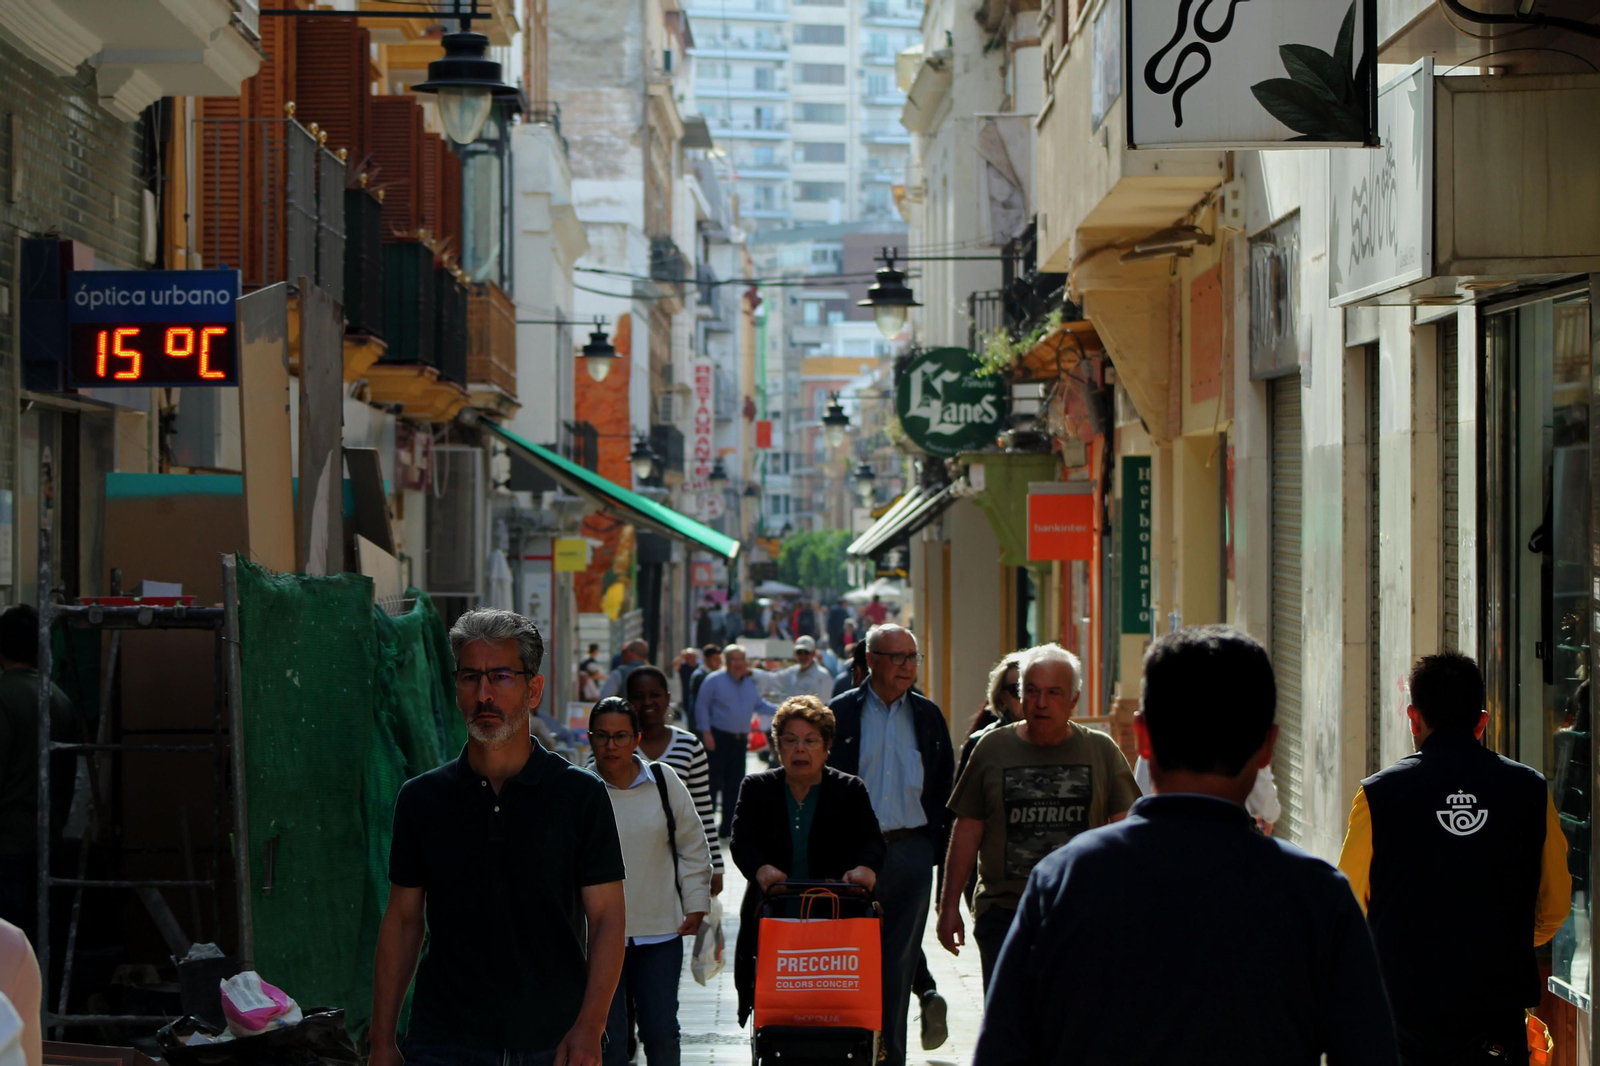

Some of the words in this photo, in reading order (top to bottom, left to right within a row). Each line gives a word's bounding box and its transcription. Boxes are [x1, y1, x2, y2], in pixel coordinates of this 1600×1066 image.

[75, 285, 146, 310] óptica
[150, 284, 231, 306] urbano
[95, 327, 142, 380] 15
[694, 366, 711, 476] RESTAURANTE
[1033, 523, 1088, 533] bankinter
[1137, 466, 1151, 622] Herbolario
[1009, 805, 1085, 824] DISTRICT
[776, 954, 860, 973] PRECCHIO
[775, 980, 814, 989] COLORS
[815, 979, 860, 988] CONCEPT
[793, 1014, 814, 1022] SHOP
[814, 1014, 841, 1022] ONLINE
